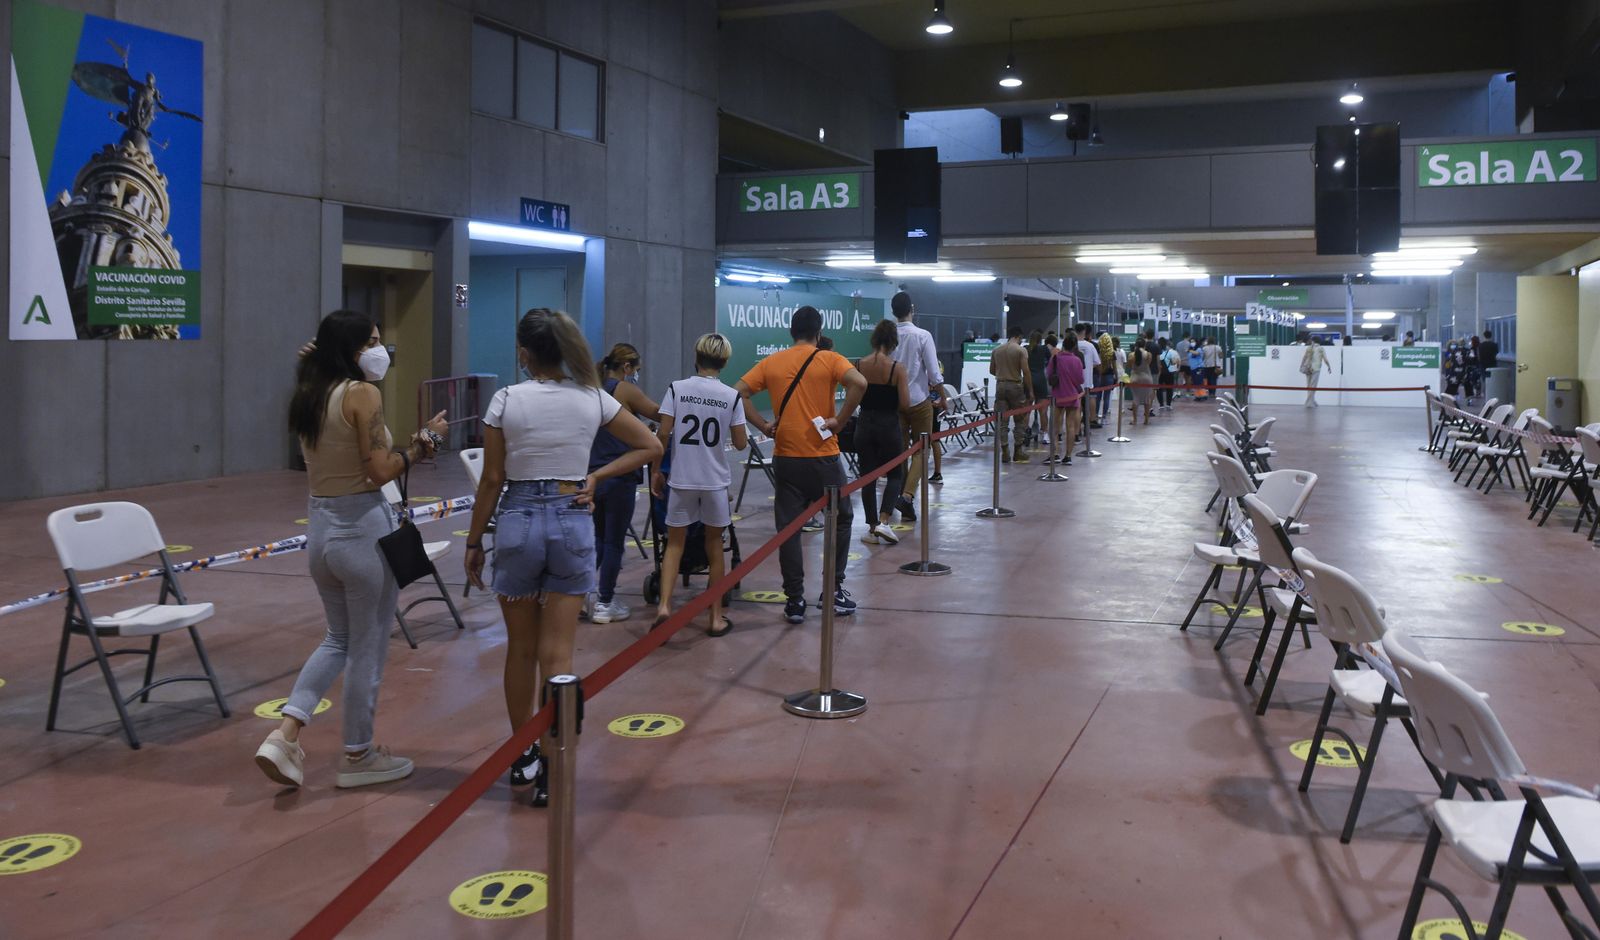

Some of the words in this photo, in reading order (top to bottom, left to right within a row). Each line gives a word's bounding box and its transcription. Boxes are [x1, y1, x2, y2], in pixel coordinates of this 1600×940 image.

[1428, 151, 1515, 186] Sala
[1525, 149, 1584, 183] A2
[746, 183, 804, 212] Sala
[810, 182, 850, 209] A3
[524, 203, 545, 223] WC
[95, 272, 157, 284] VACUNACIÓN
[158, 275, 186, 285] COVID
[95, 295, 125, 304] Distrito
[126, 296, 161, 305] Sanitario
[161, 298, 186, 306] Sevilla
[728, 303, 799, 329] VACUNACI
[680, 395, 702, 405] MARCO
[702, 398, 728, 409] ASENSIO
[680, 413, 720, 448] 20
